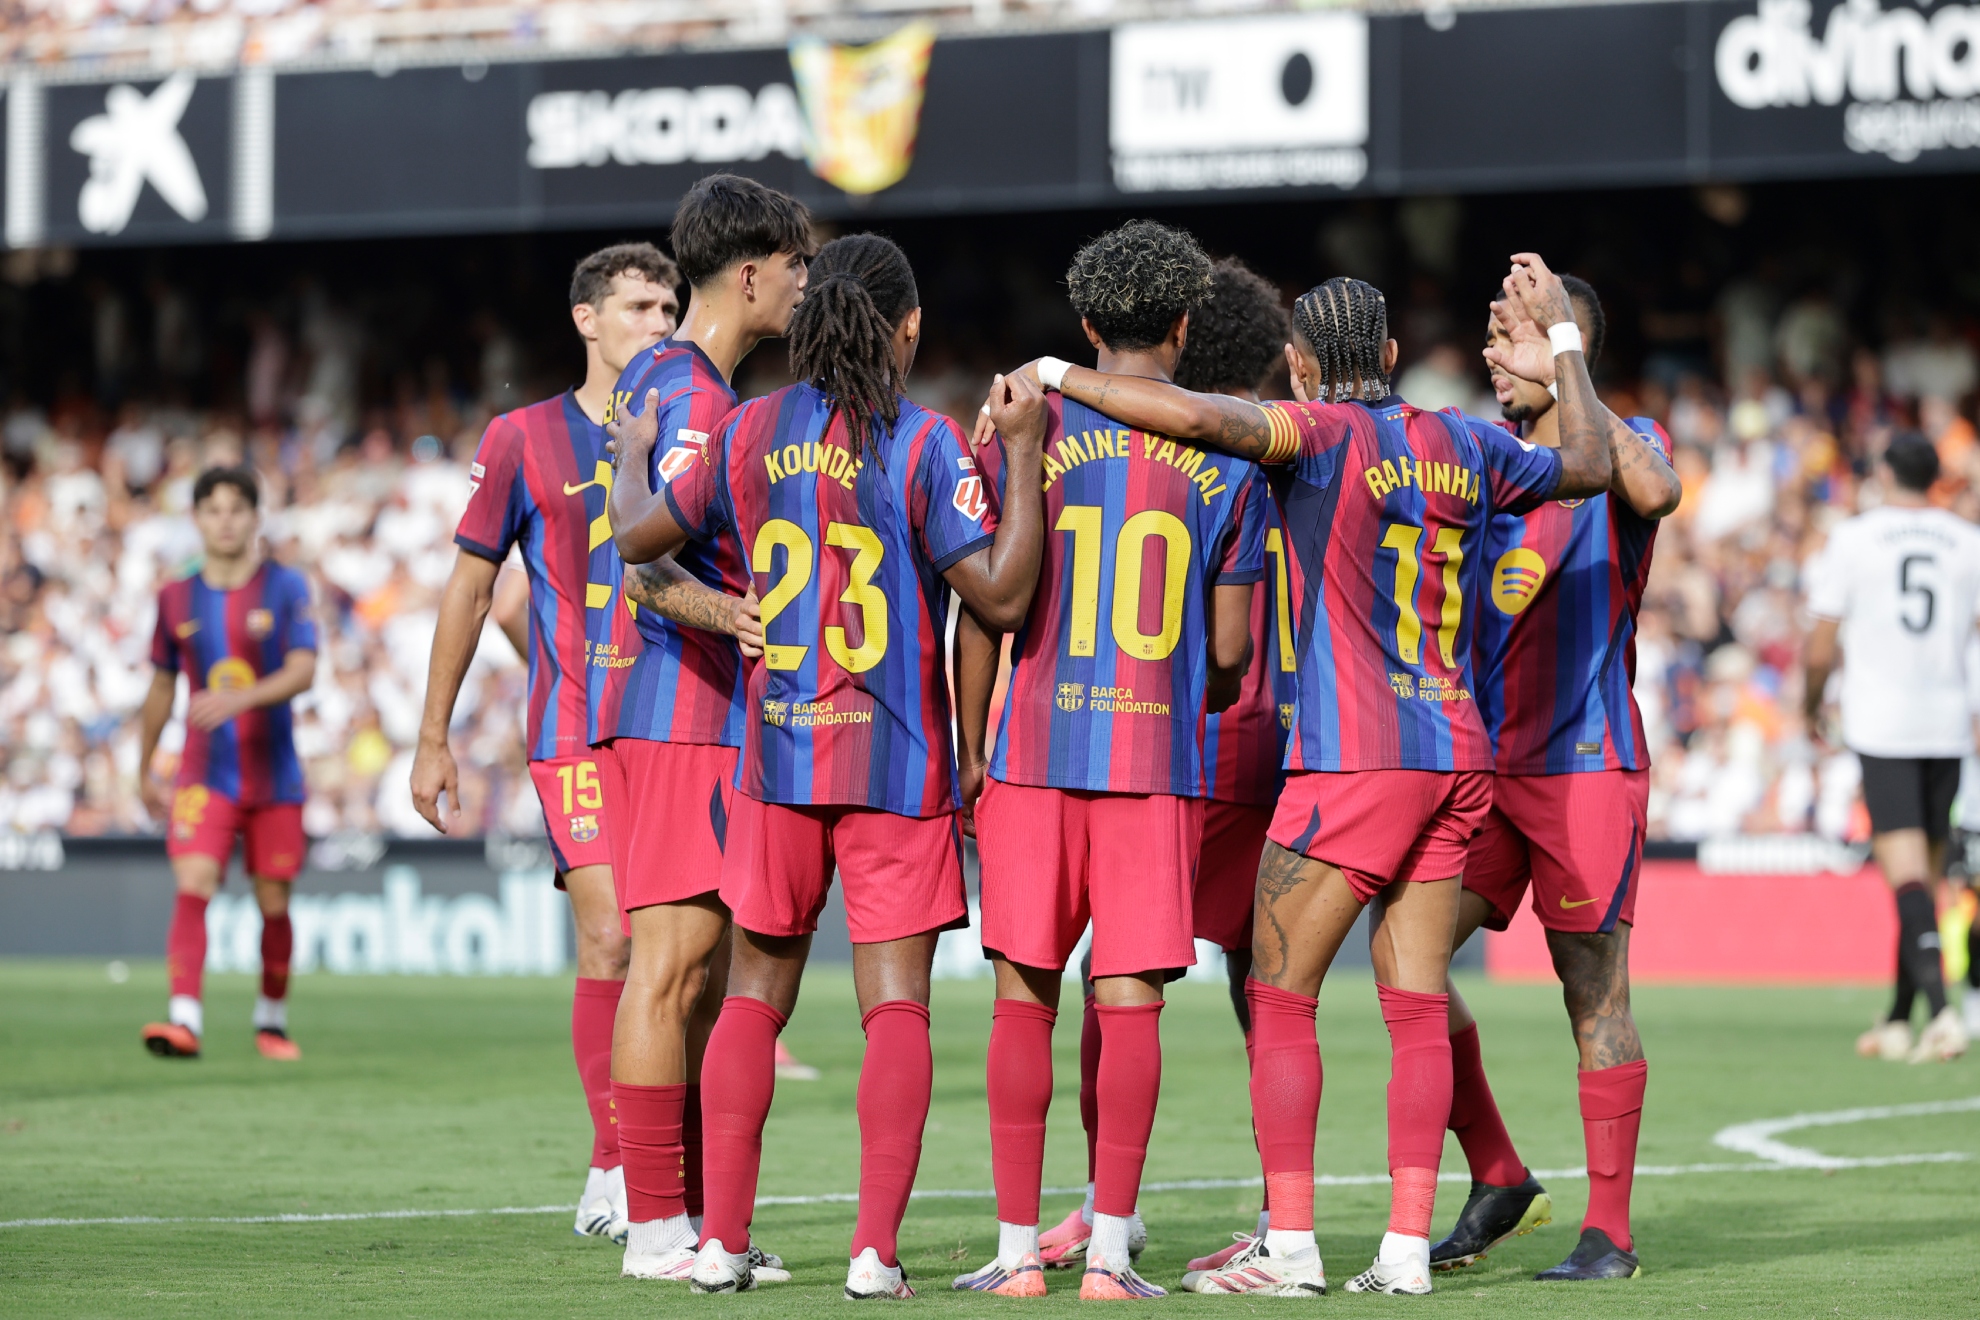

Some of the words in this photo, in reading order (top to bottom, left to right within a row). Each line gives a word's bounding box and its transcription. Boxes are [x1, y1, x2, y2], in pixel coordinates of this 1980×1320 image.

[763, 441, 864, 491] KOUNDE
[1143, 432, 1227, 506] YAMAL
[752, 518, 888, 673] 23
[1054, 505, 1192, 661] 10
[1380, 522, 1466, 668] 11
[1899, 553, 1936, 635] 5
[792, 702, 834, 715] BARÇA
[1090, 699, 1170, 715] FOUNDATION
[1091, 686, 1134, 701] BARÇA
[1419, 677, 1452, 690] BARÇA
[791, 711, 872, 727] FOUNDATION
[556, 761, 603, 815] 15
